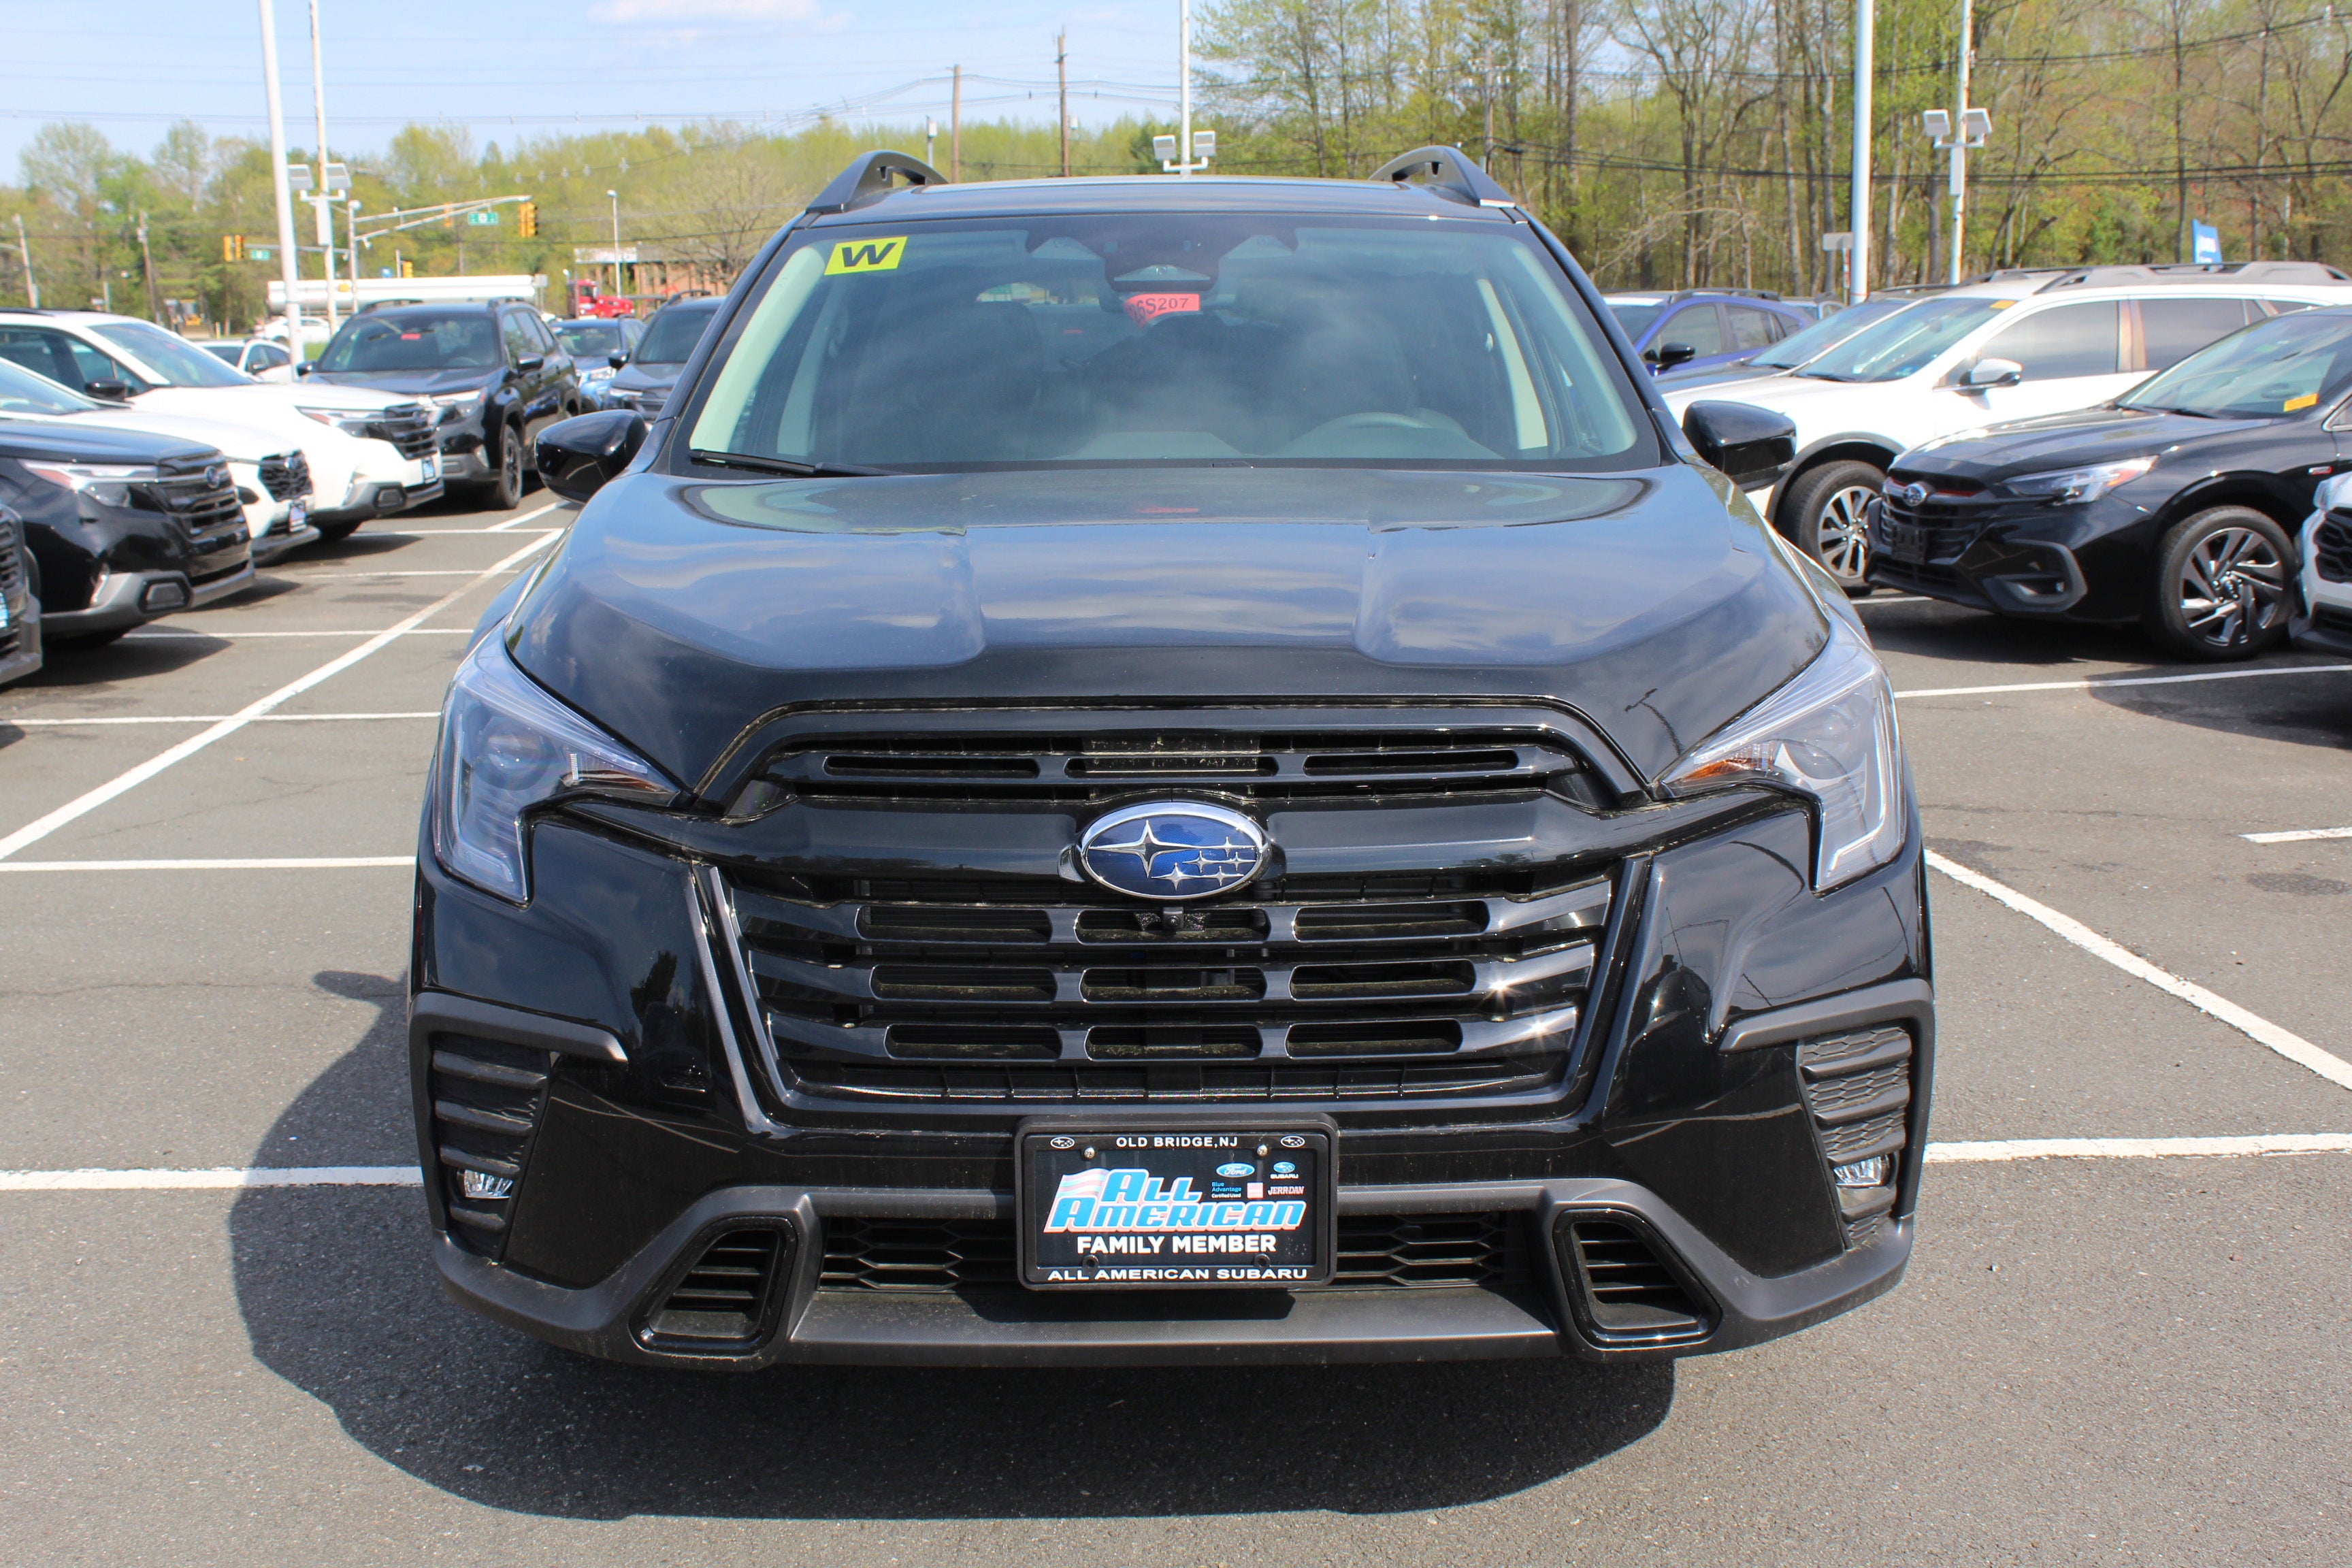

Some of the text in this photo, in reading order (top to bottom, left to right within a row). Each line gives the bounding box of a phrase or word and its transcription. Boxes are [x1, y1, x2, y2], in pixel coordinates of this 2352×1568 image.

[842, 242, 897, 267] W
[1116, 1137, 1147, 1147] OLD
[1224, 1164, 1247, 1175] Ford
[1077, 1235, 1277, 1254] FAMILY MEMBER
[1047, 1269, 1307, 1281] ALL AMERICAN SUBARU
